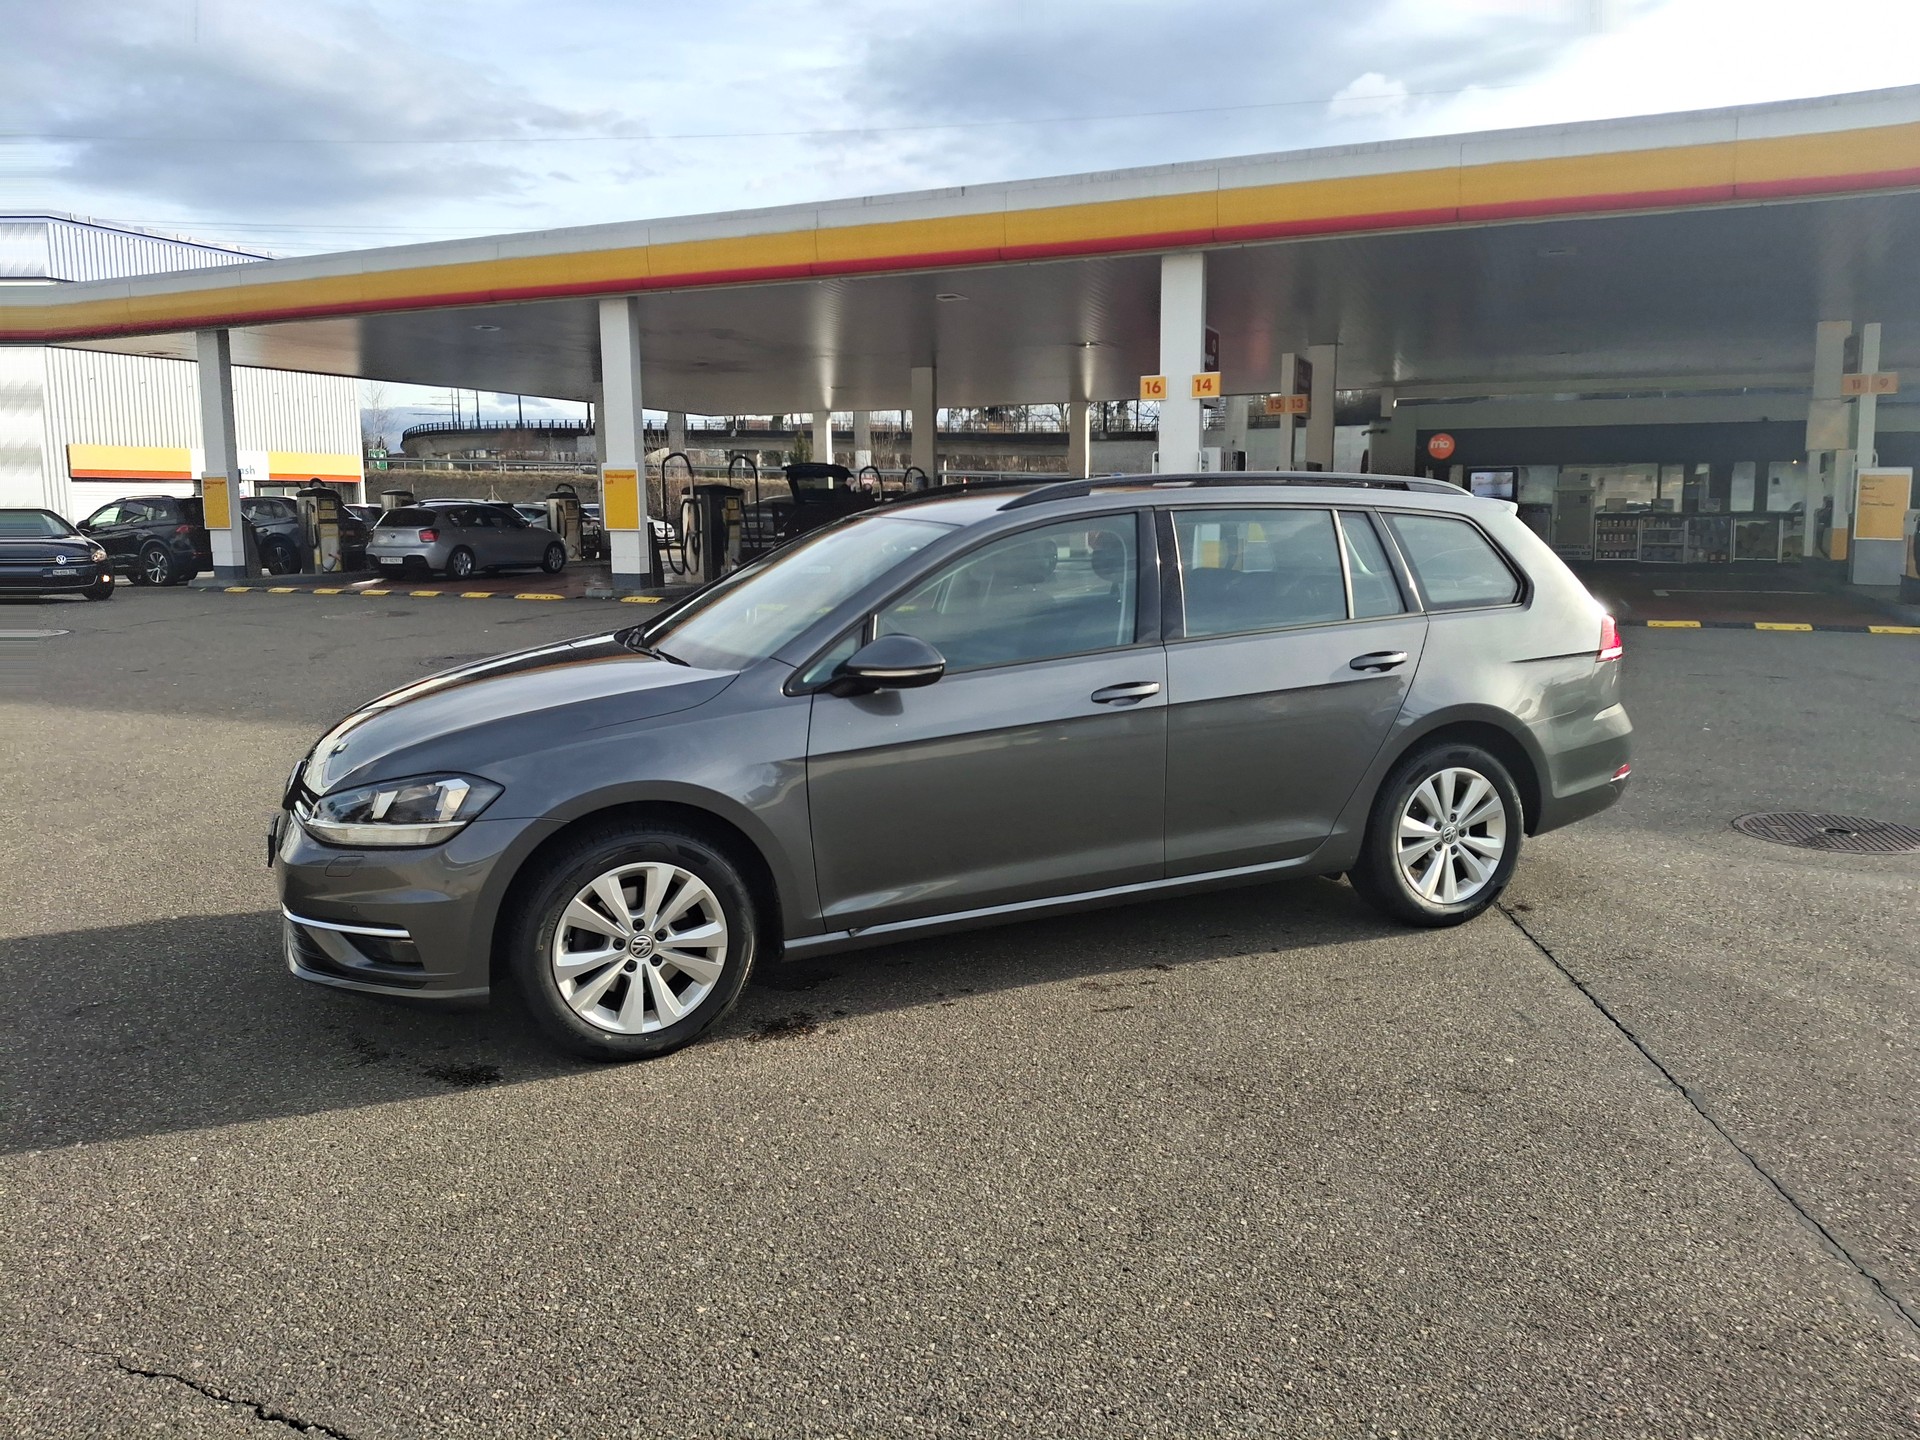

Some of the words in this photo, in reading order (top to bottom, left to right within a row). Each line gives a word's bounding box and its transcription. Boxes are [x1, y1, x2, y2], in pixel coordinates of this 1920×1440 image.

[1145, 381, 1162, 394] 16
[1195, 378, 1213, 392] 14
[1270, 399, 1282, 410] 15
[1291, 398, 1304, 409] 13
